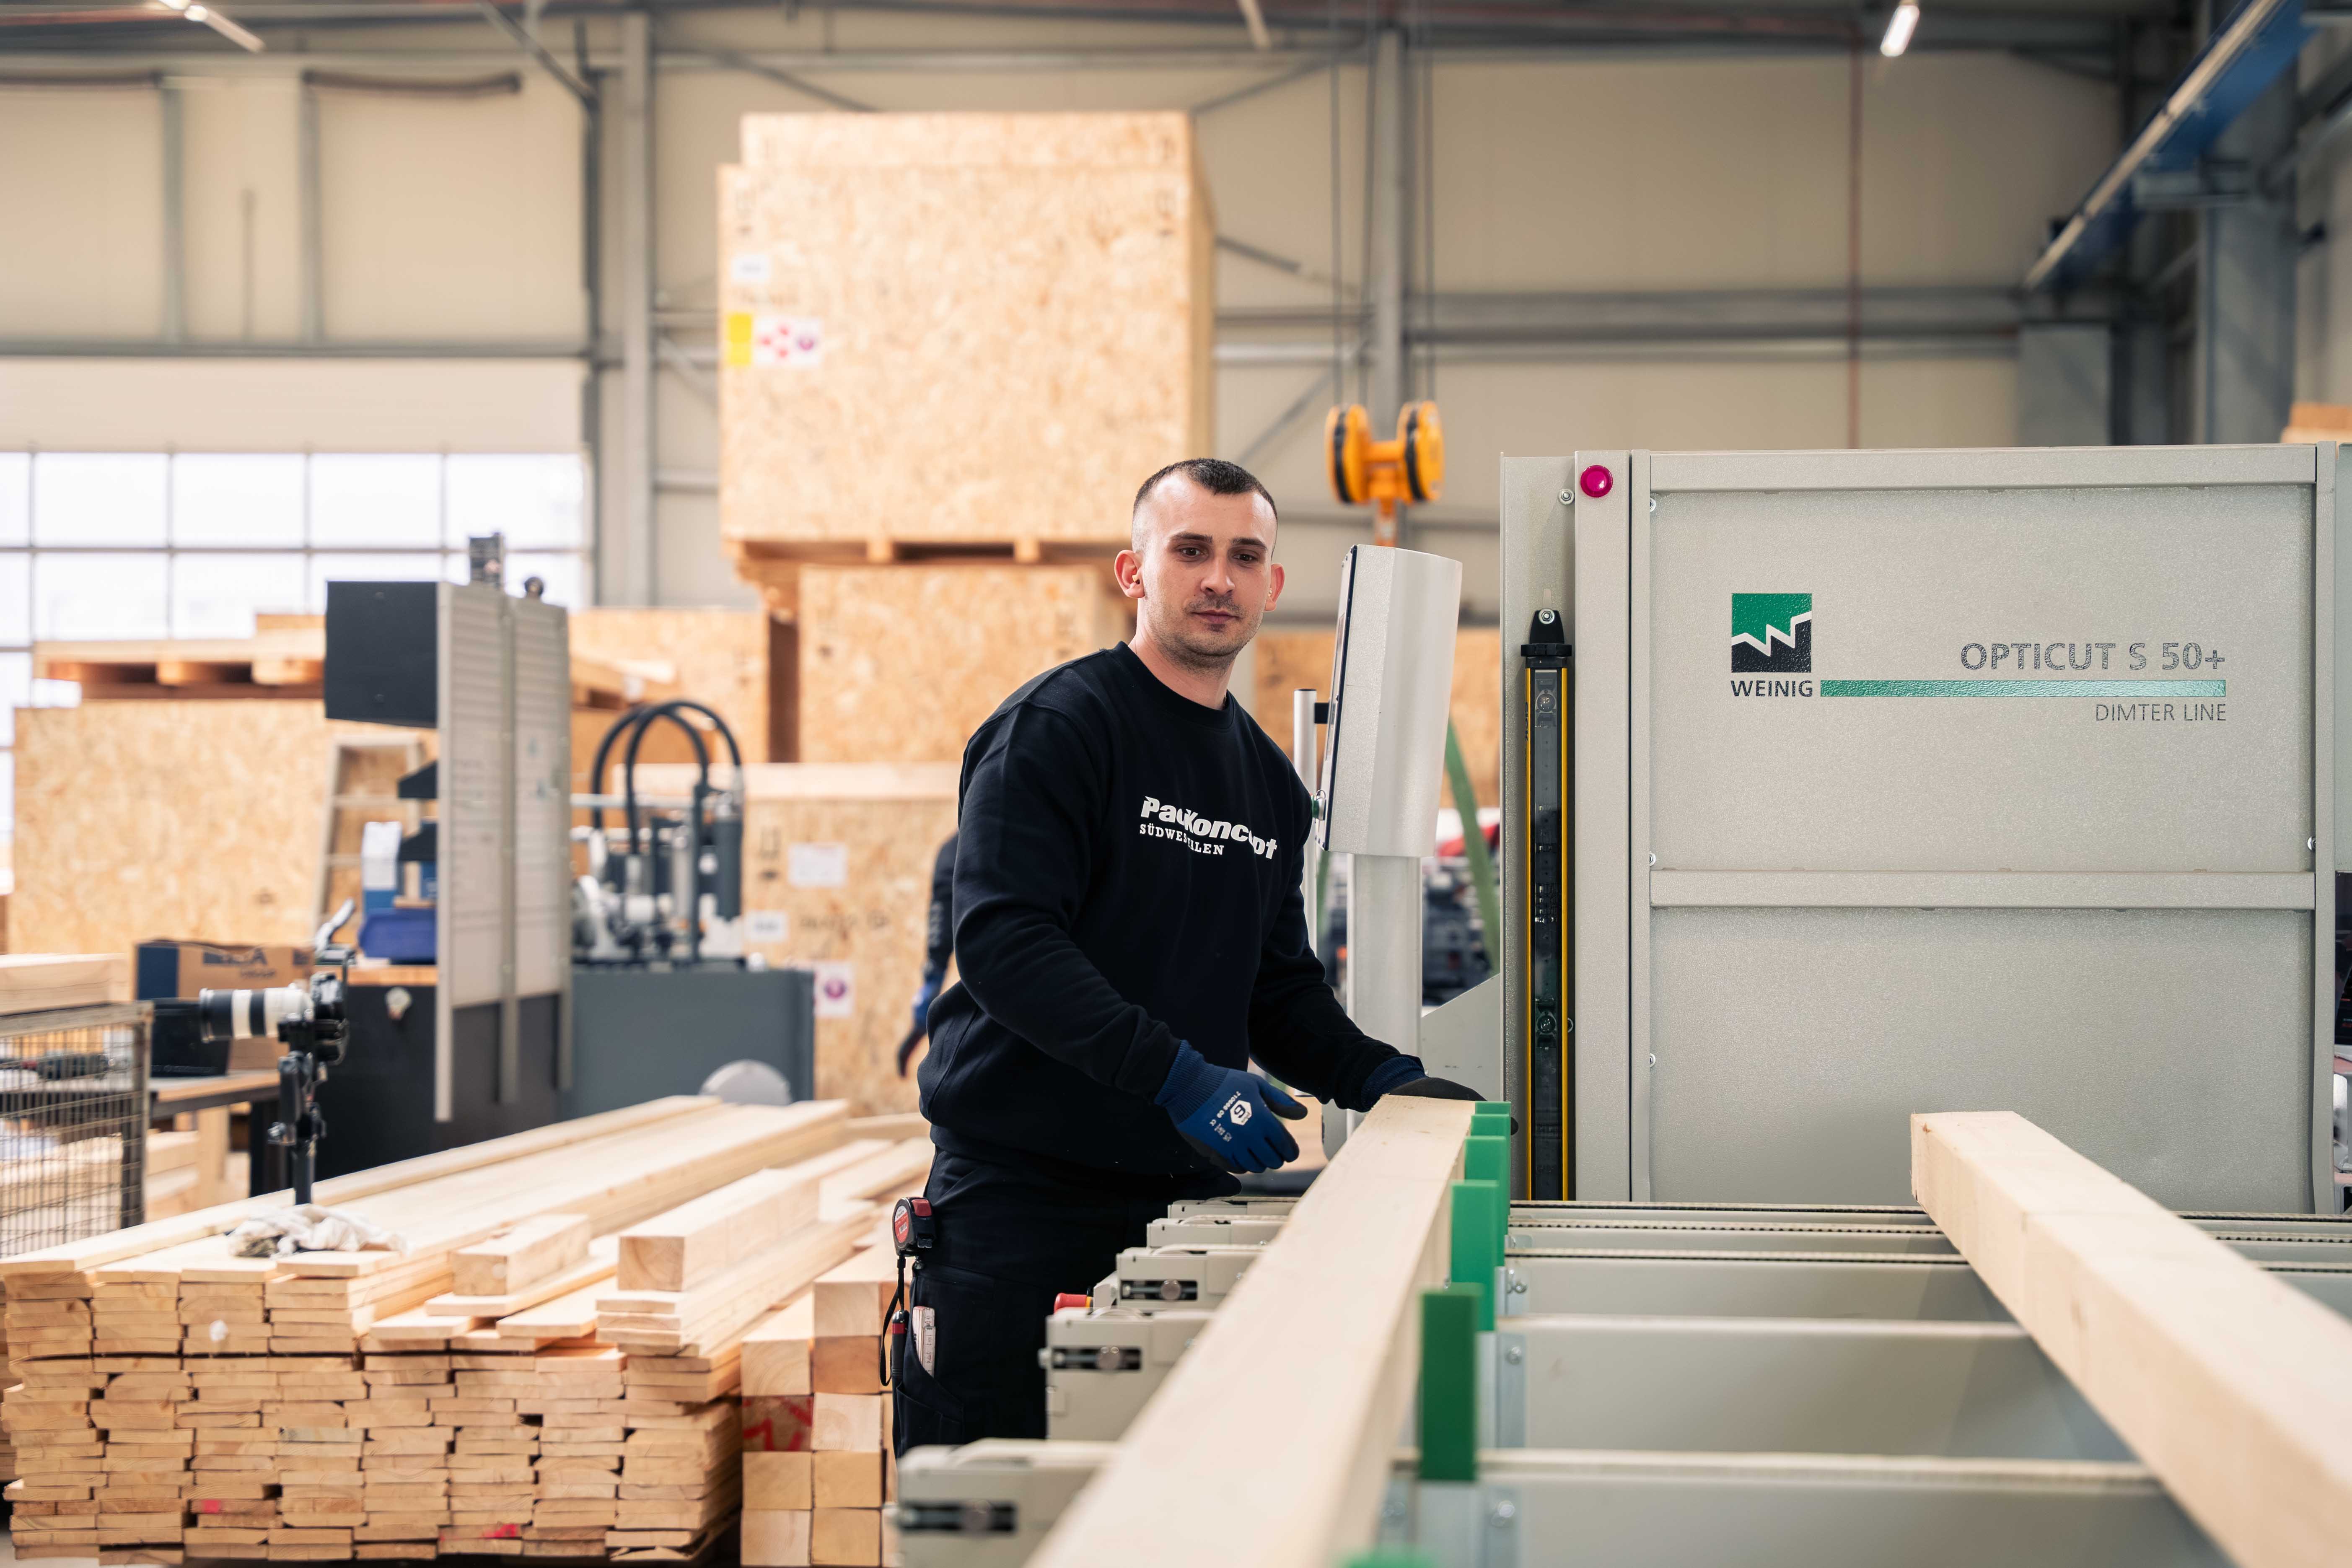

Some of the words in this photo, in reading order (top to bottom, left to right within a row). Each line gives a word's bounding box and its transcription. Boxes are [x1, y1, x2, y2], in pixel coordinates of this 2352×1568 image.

[1961, 643, 2116, 670] OPTICUT
[2129, 643, 2146, 670] S
[2162, 643, 2225, 670] 50+
[1730, 680, 1813, 697] WEINIG
[2096, 704, 2175, 721] DIMTER
[2184, 704, 2226, 721] LINE
